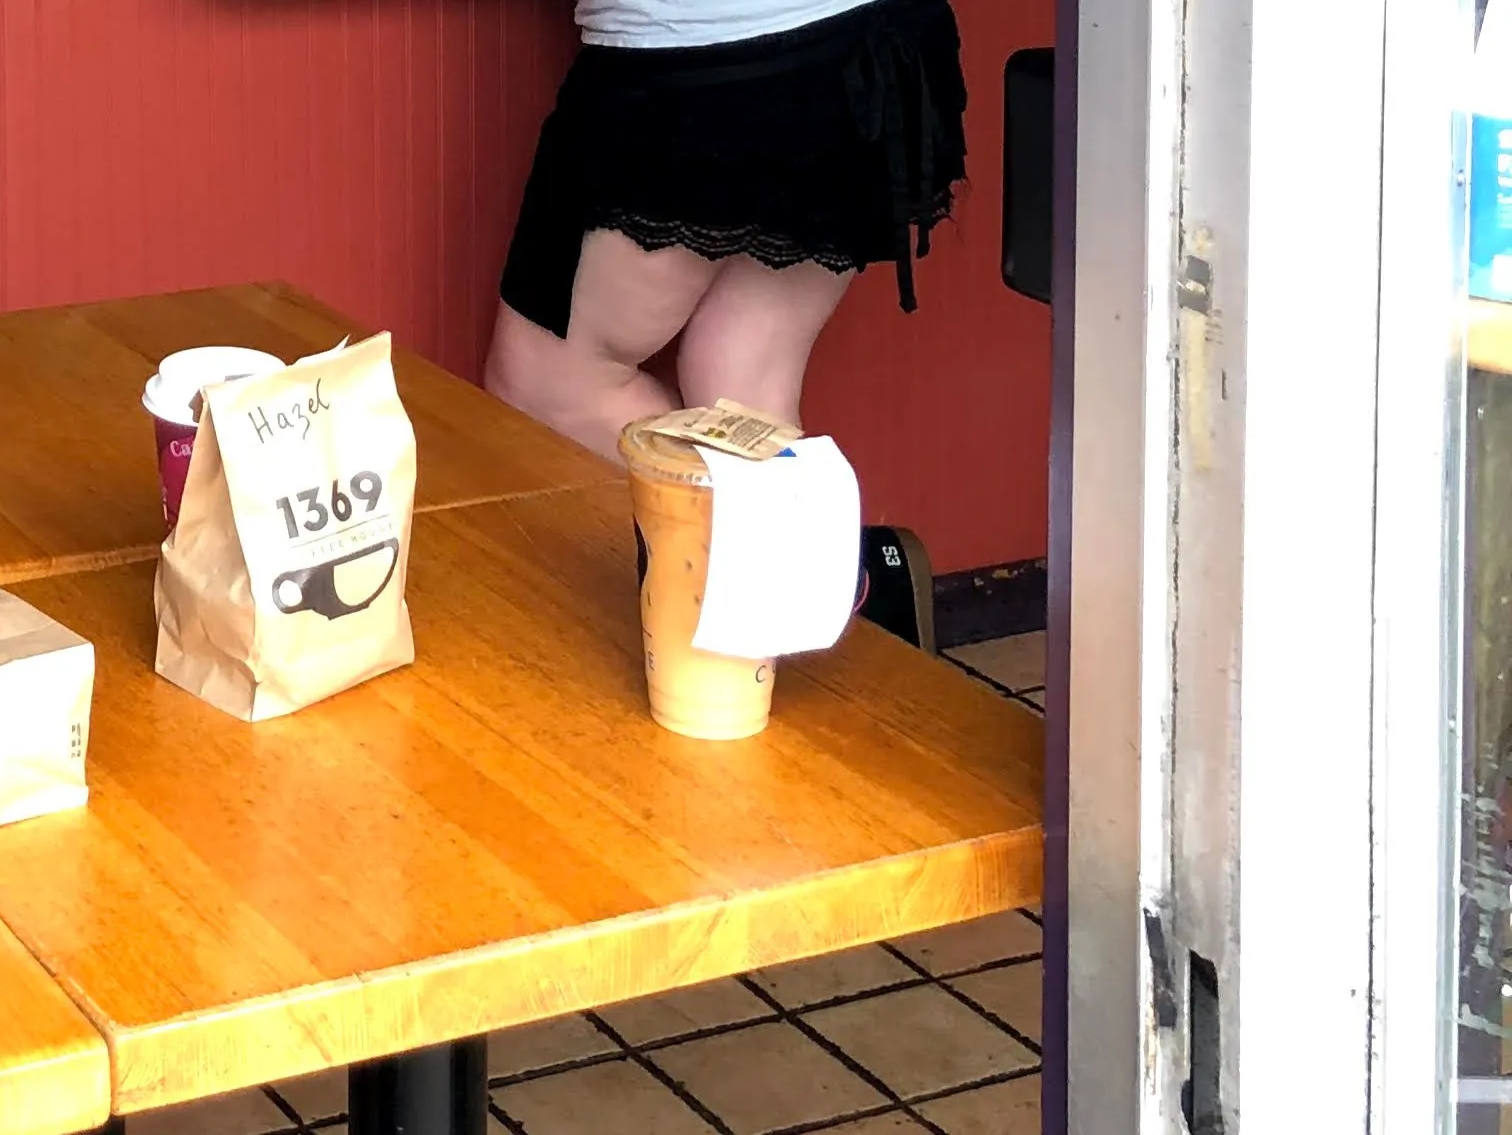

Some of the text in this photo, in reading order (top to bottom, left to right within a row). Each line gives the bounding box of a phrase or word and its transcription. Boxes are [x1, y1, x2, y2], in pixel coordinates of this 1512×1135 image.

[248, 378, 330, 444] Hazel
[169, 439, 195, 458] Ca
[275, 470, 383, 540] 1369
